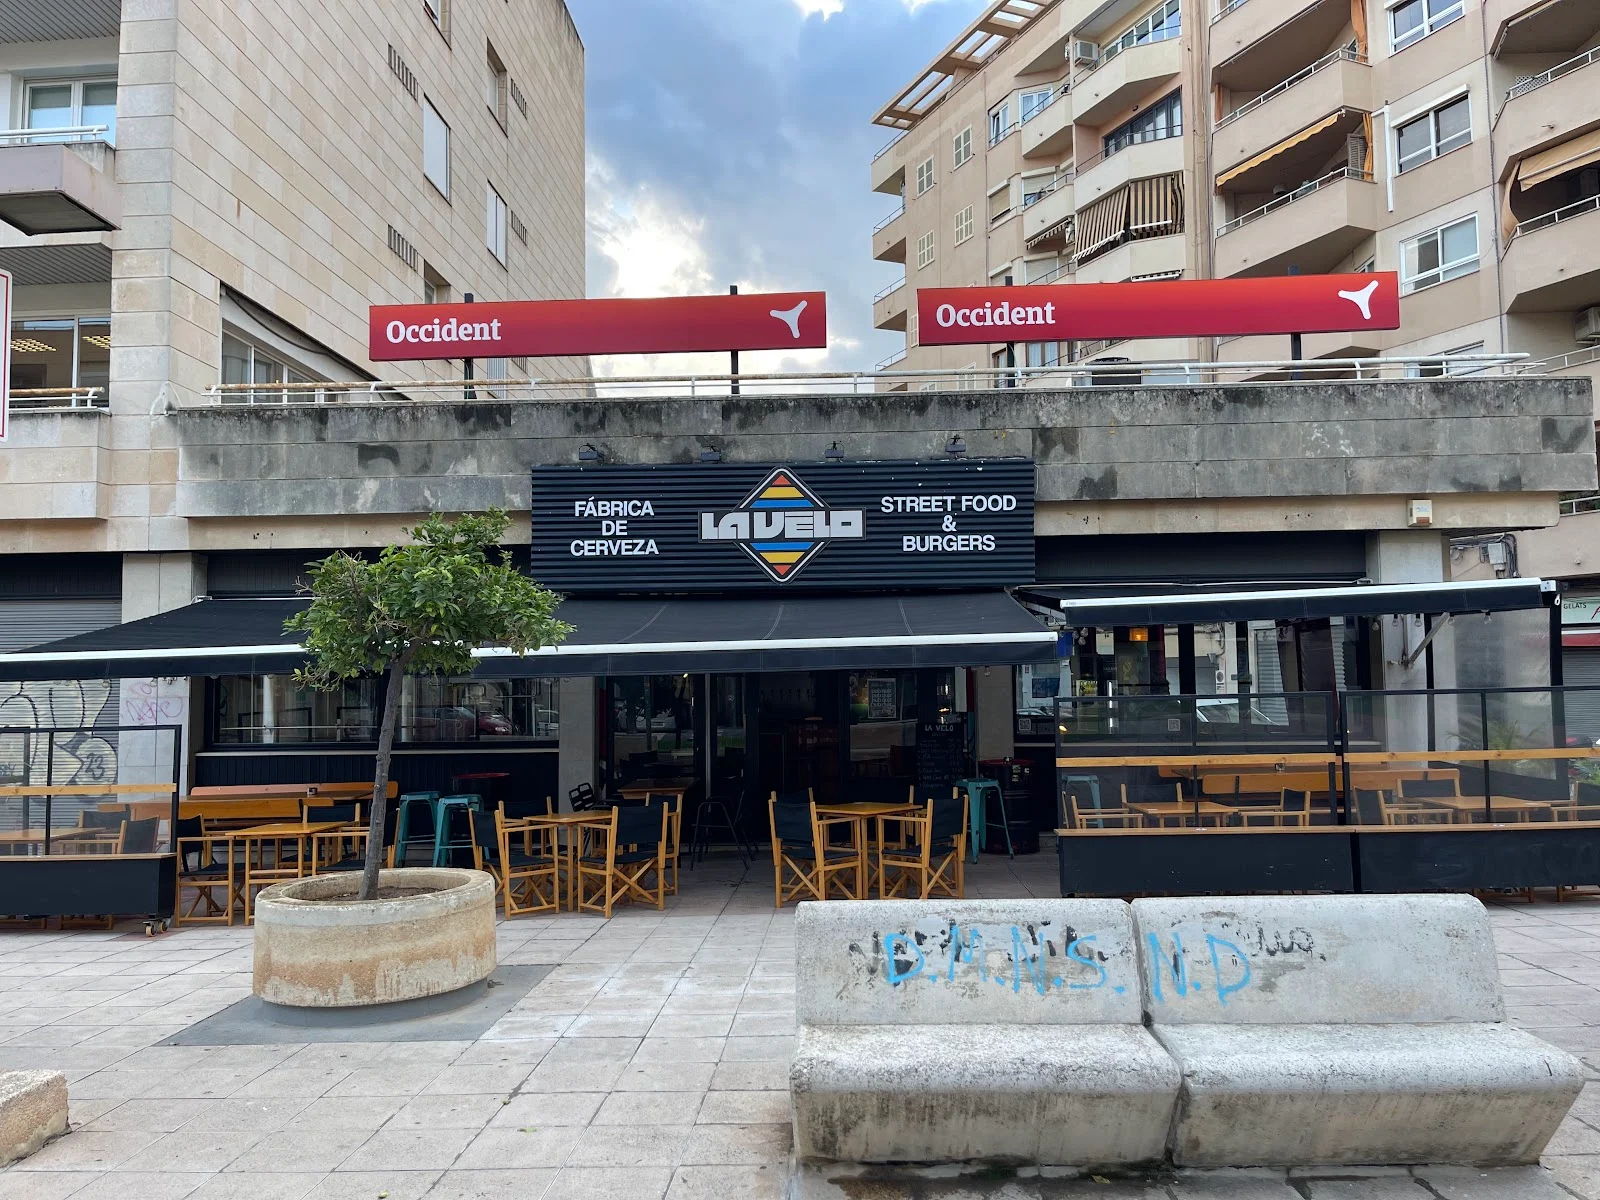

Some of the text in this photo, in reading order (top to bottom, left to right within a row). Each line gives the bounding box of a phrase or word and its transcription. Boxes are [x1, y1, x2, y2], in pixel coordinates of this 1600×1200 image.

[936, 301, 1056, 327] Occident
[386, 317, 502, 343] Occident
[574, 496, 655, 517] FÁBRICA
[880, 494, 1017, 512] STREET FOOD
[601, 520, 628, 536] DE
[941, 514, 957, 532] &
[570, 539, 660, 556] CERVEZA
[902, 534, 996, 552] BURGERS
